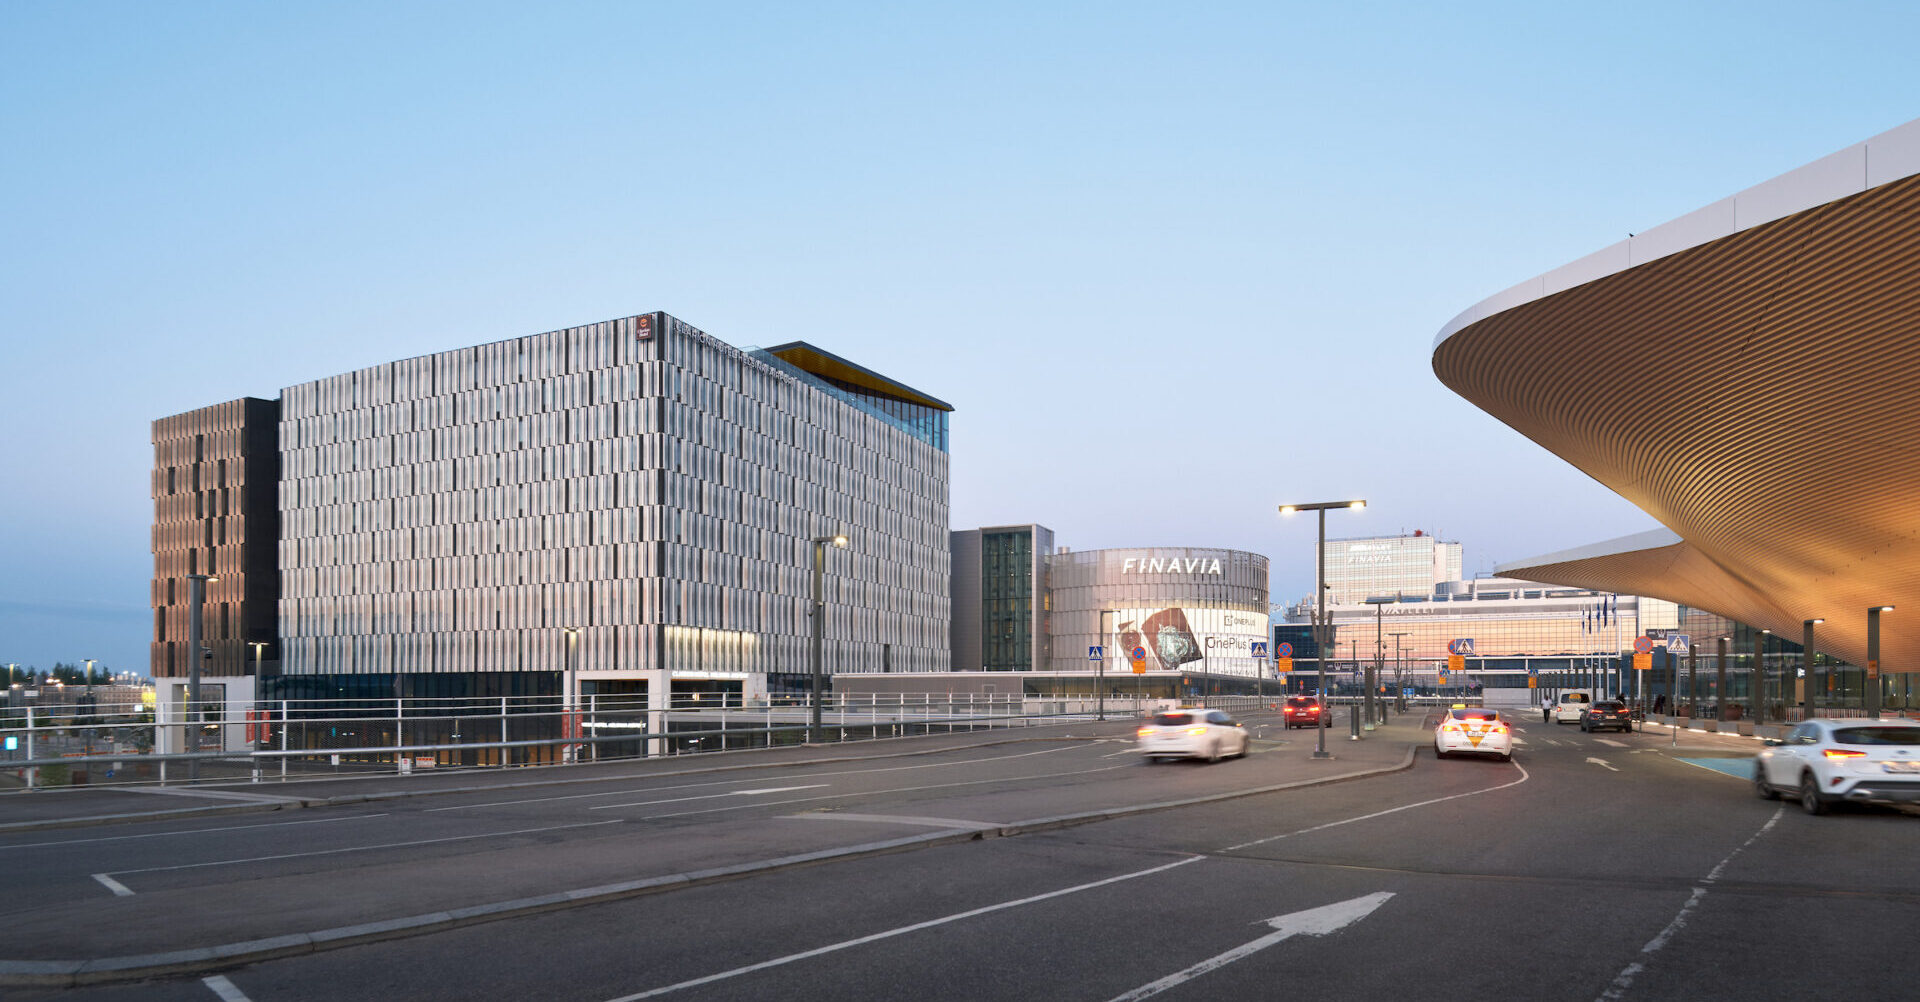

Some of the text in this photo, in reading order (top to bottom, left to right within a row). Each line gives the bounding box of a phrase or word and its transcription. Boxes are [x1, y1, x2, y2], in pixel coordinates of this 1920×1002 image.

[674, 321, 711, 346] CLARION
[713, 339, 738, 359] HOTEL
[1123, 558, 1220, 574] FINAVIA
[1234, 618, 1256, 627] ONEPLUS
[1207, 637, 1247, 650] OnePlus
